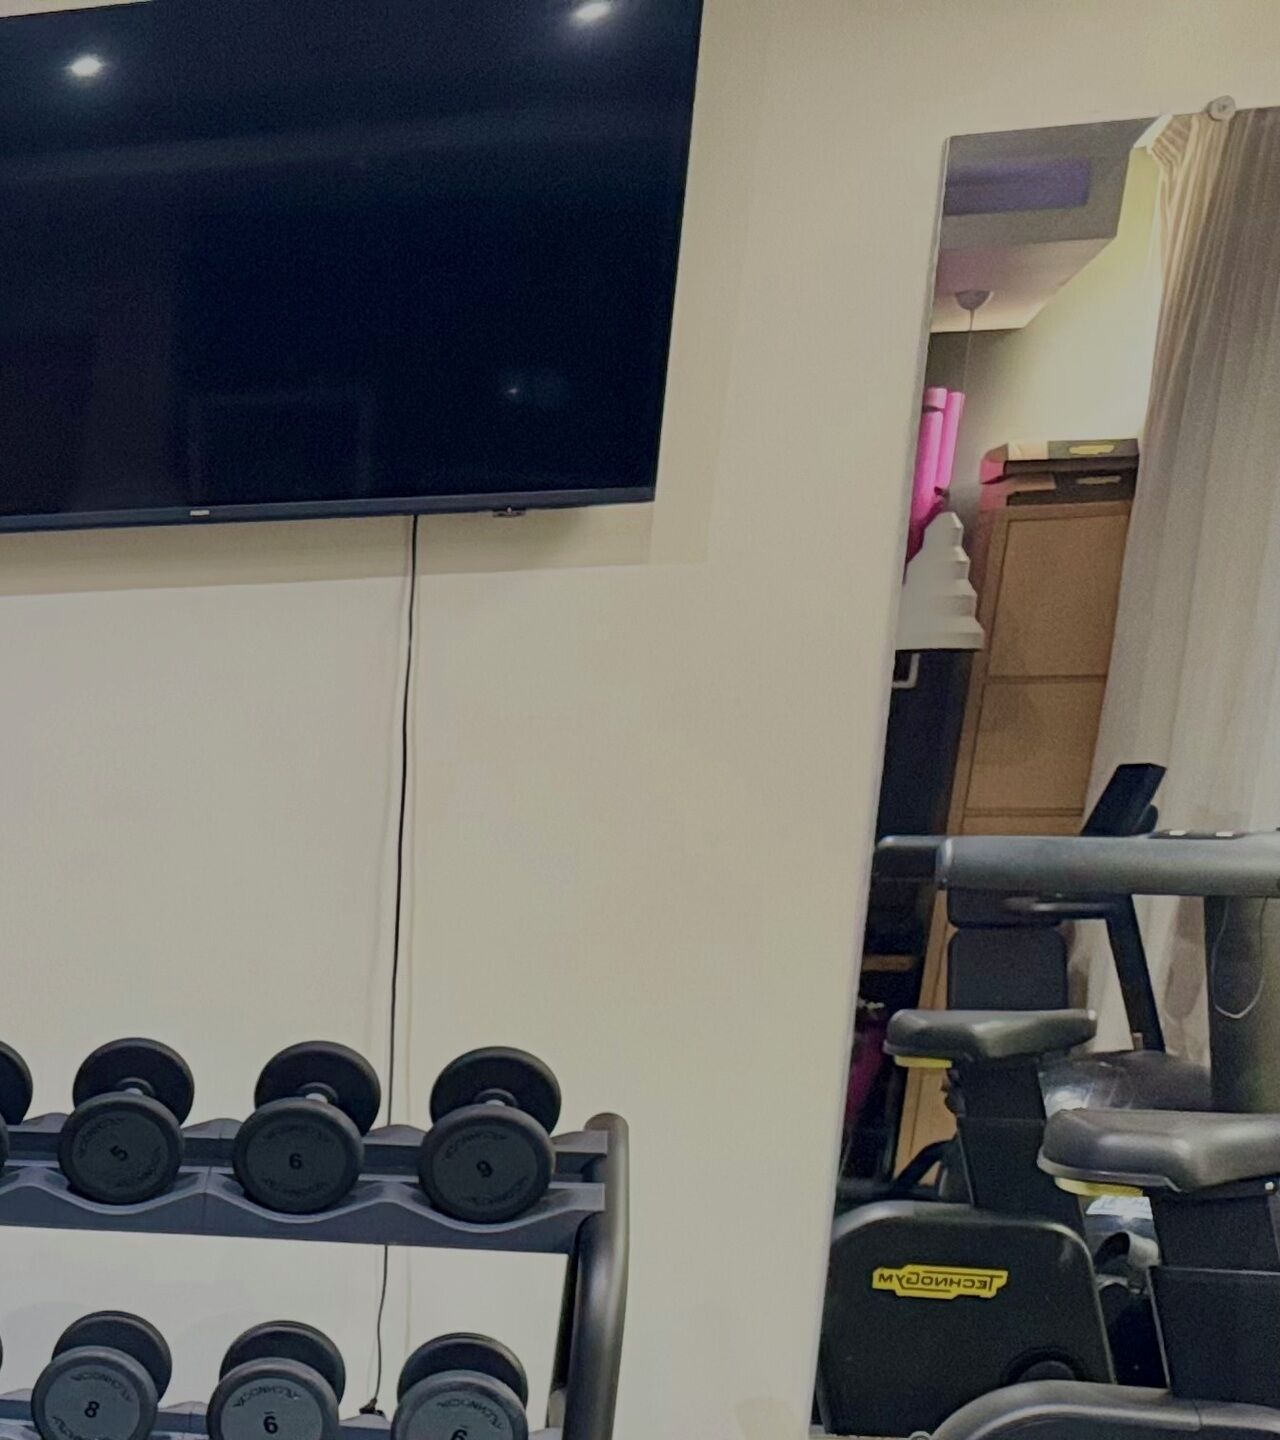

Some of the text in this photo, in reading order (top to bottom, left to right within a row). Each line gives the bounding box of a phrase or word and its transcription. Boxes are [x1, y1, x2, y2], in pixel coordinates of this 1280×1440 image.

[109, 1144, 130, 1164] 5
[287, 1152, 304, 1171] 6
[83, 1400, 102, 1420] 8
